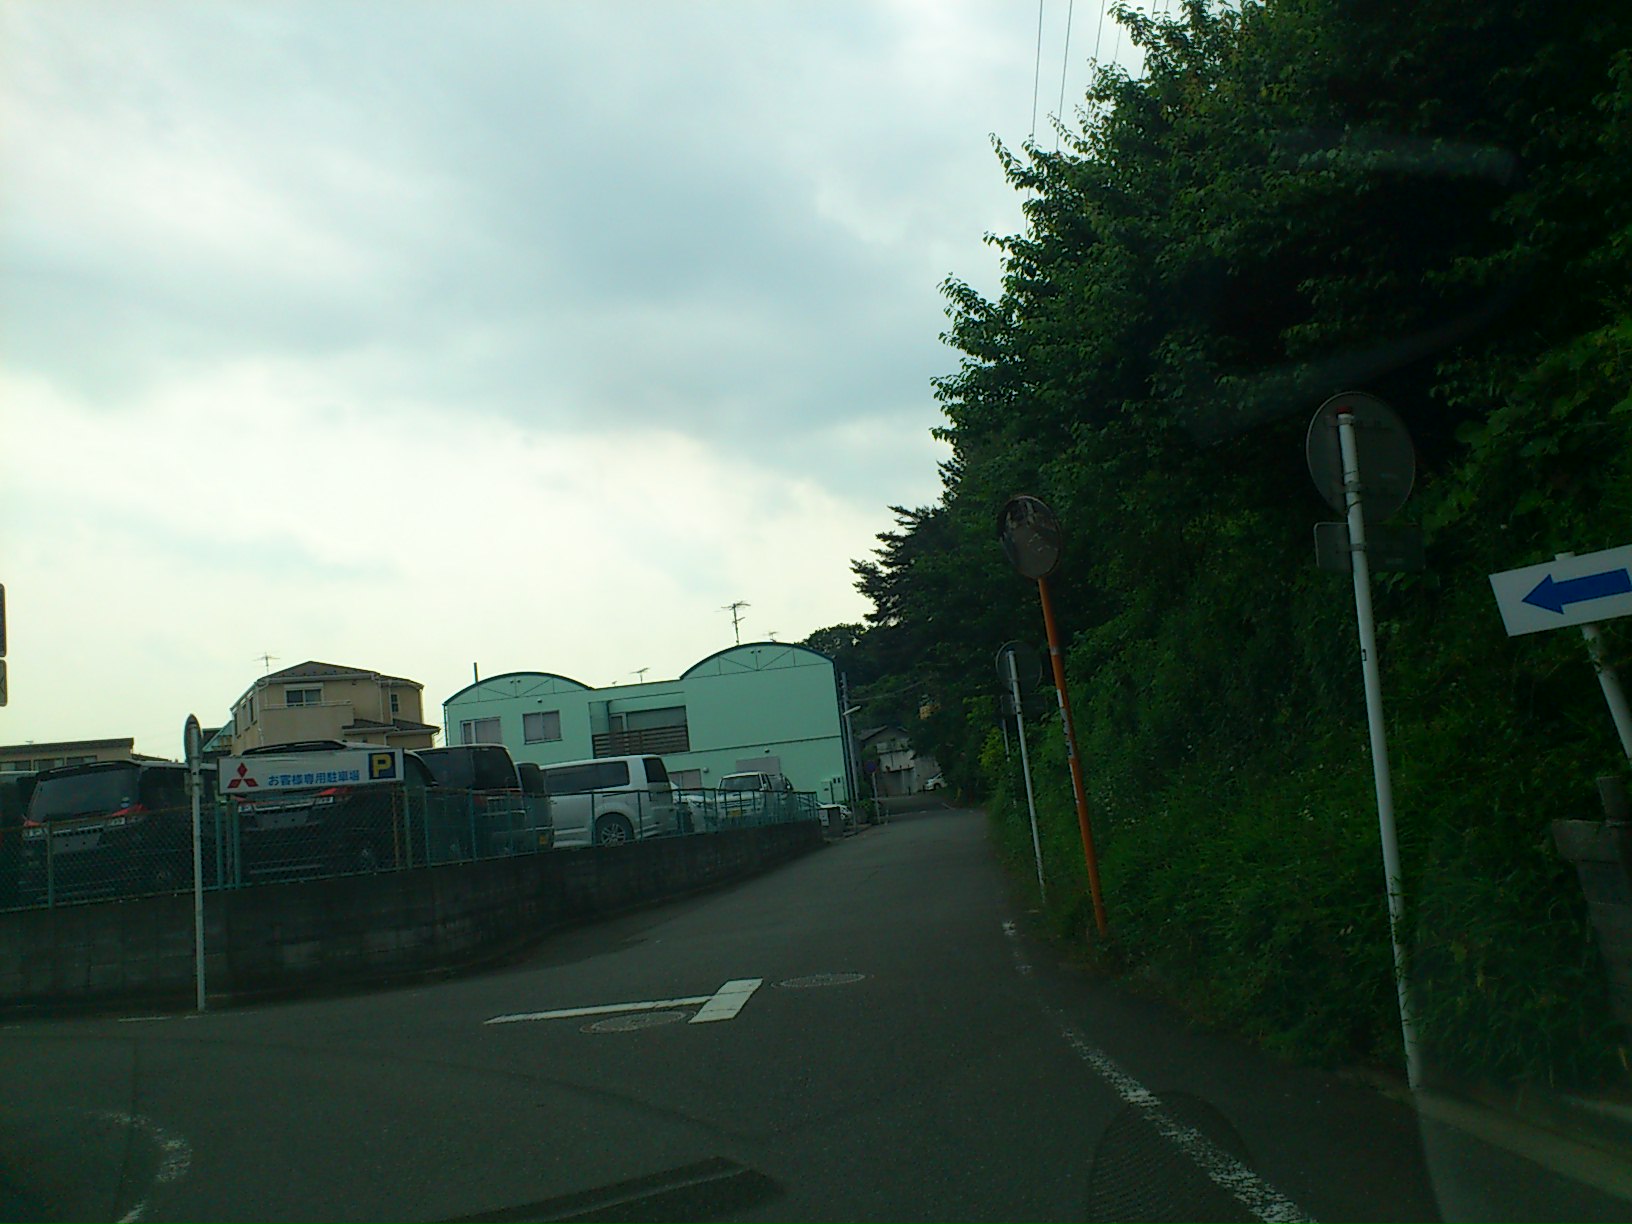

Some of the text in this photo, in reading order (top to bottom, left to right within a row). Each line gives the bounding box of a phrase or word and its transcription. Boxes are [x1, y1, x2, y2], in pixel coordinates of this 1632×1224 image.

[372, 753, 393, 779] P
[268, 770, 360, 786] お客様専用駐車場
